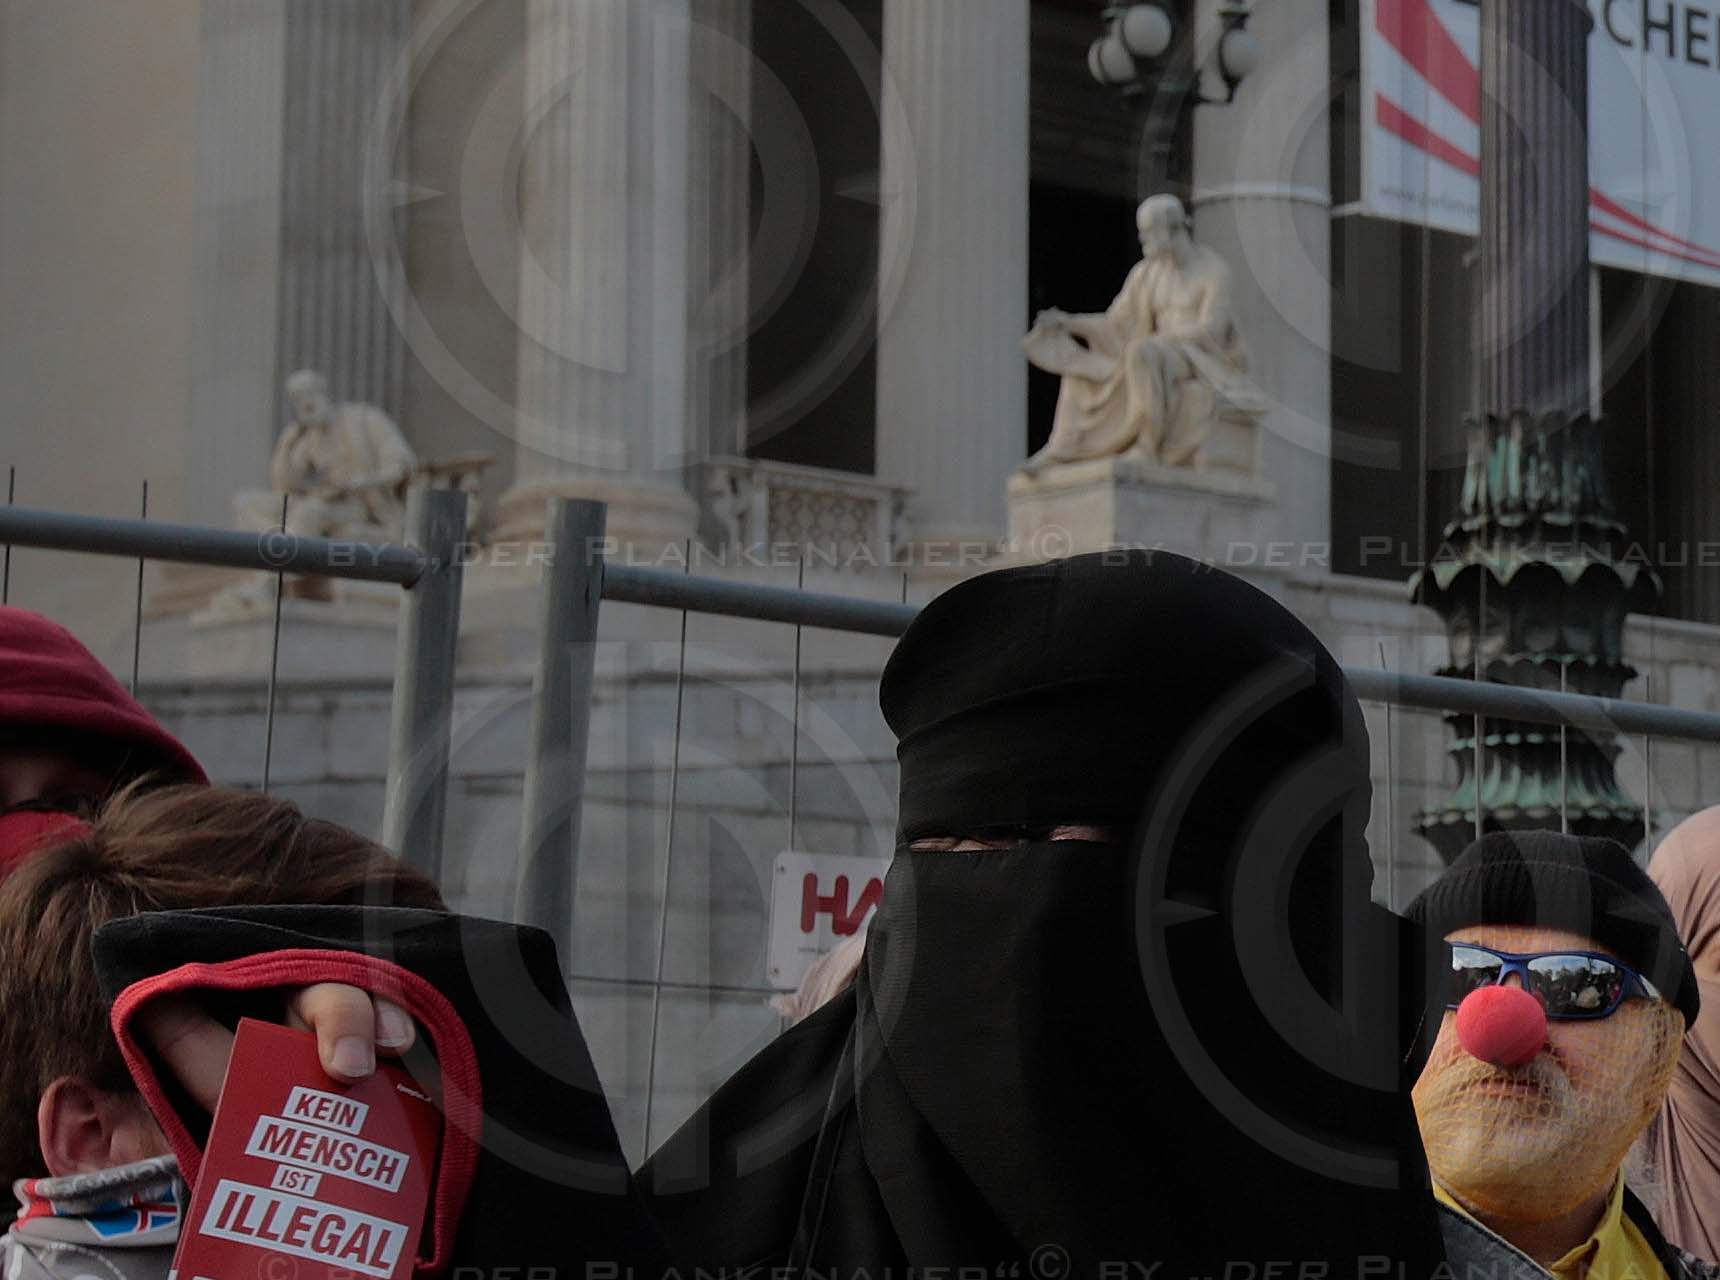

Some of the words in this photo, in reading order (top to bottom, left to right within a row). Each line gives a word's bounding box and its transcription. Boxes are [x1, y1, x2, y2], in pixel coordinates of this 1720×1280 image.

[293, 1093, 359, 1129] KEIN
[257, 1124, 401, 1186] MENSCH
[278, 1168, 315, 1193] IST
[213, 1189, 398, 1270] ILLEGAL
